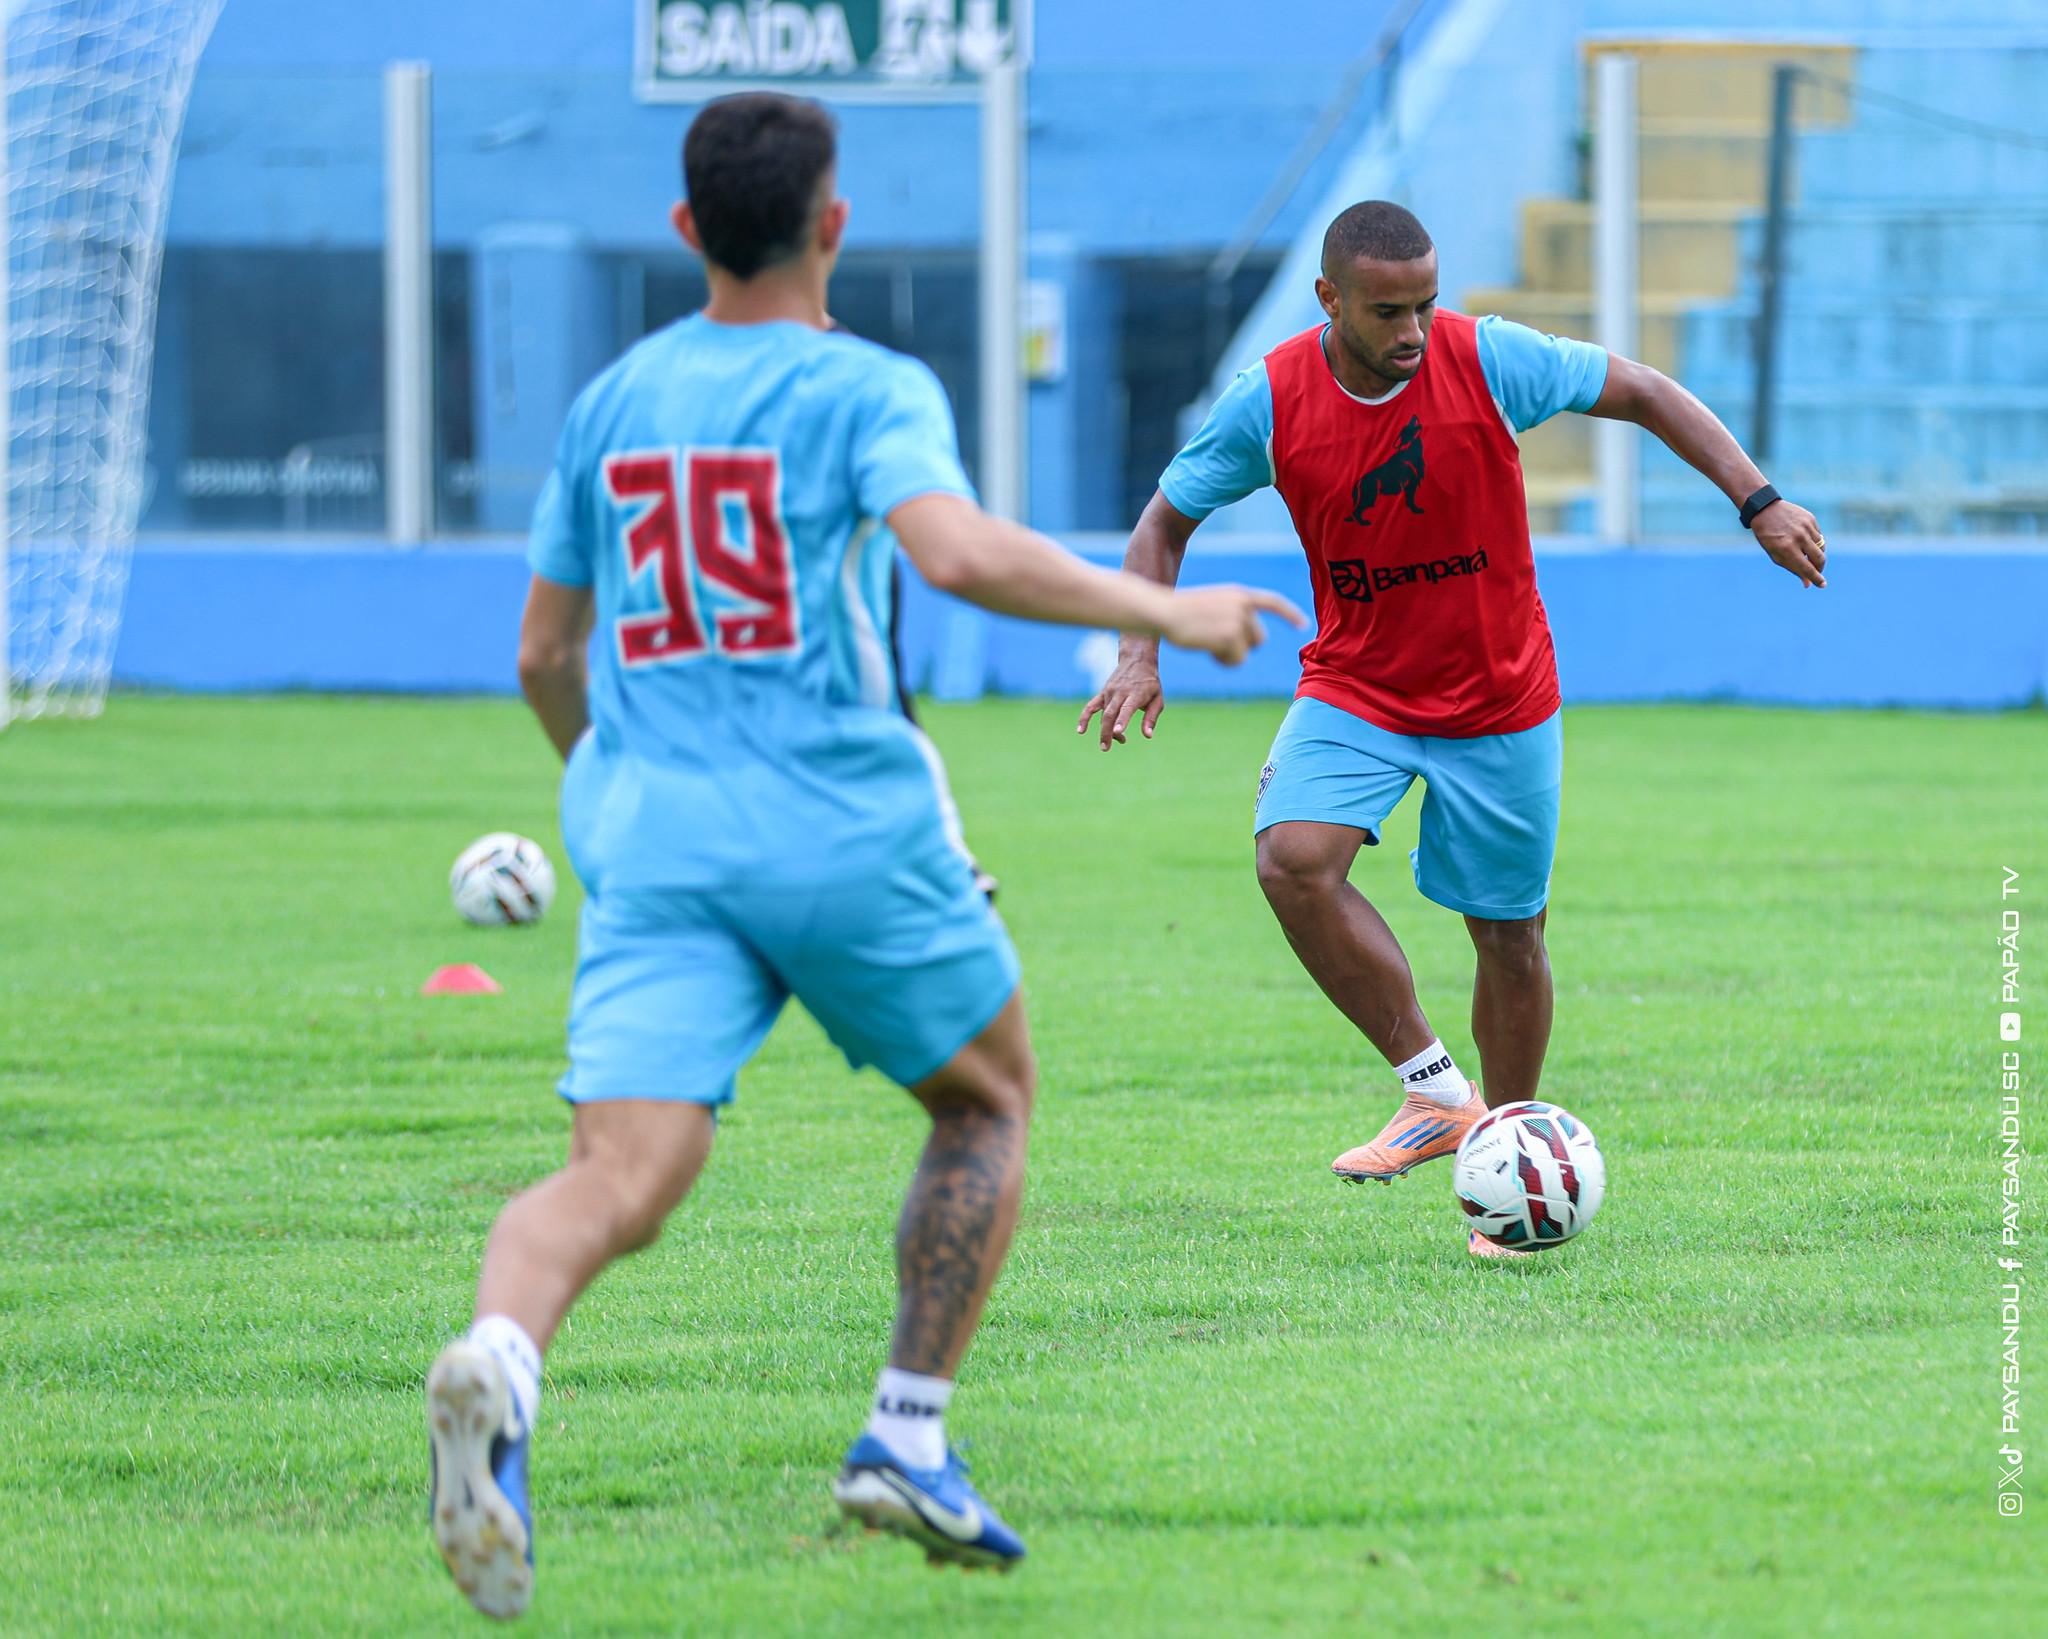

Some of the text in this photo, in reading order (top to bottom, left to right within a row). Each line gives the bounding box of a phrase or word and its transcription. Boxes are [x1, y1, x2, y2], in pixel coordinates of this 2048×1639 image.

[659, 0, 858, 75] SAÍDA
[603, 448, 802, 667] 39
[1372, 545, 1489, 592] Banpará
